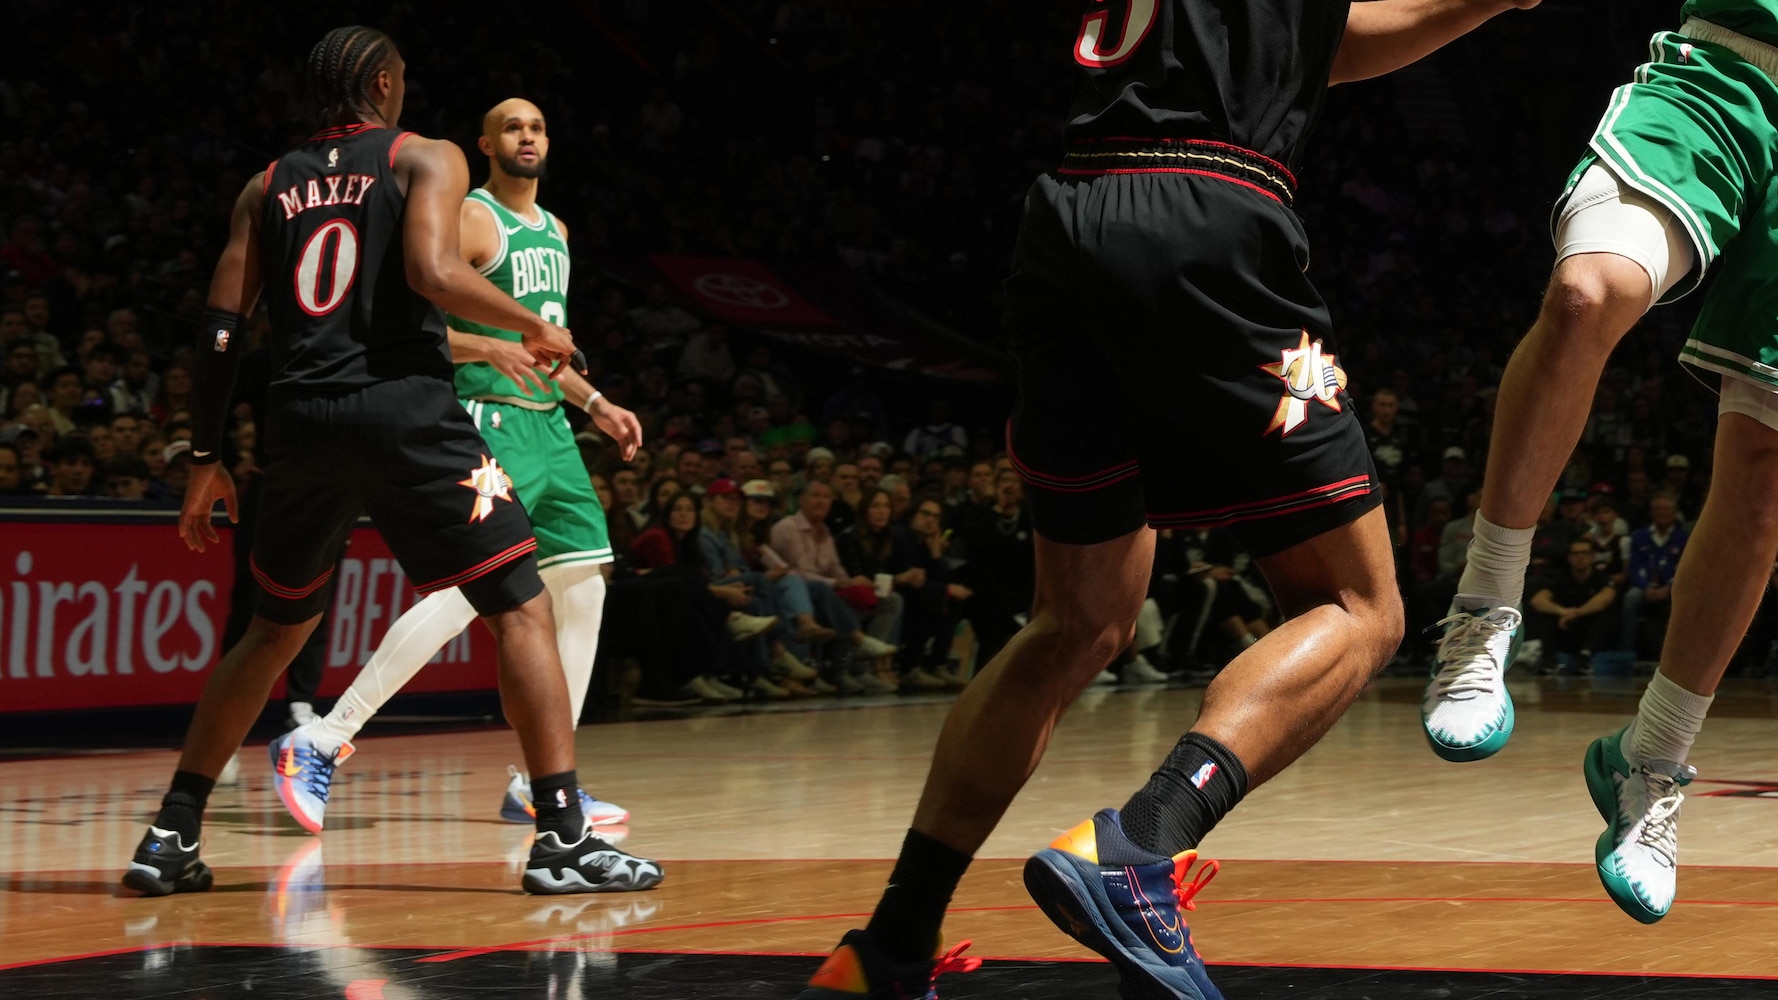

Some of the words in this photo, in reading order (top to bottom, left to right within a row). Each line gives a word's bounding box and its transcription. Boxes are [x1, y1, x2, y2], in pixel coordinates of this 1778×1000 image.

[277, 173, 376, 221] MAXEY
[293, 217, 361, 318] 0
[510, 246, 571, 299] BOSTO
[0, 551, 215, 679] irates
[328, 557, 472, 668] BET
